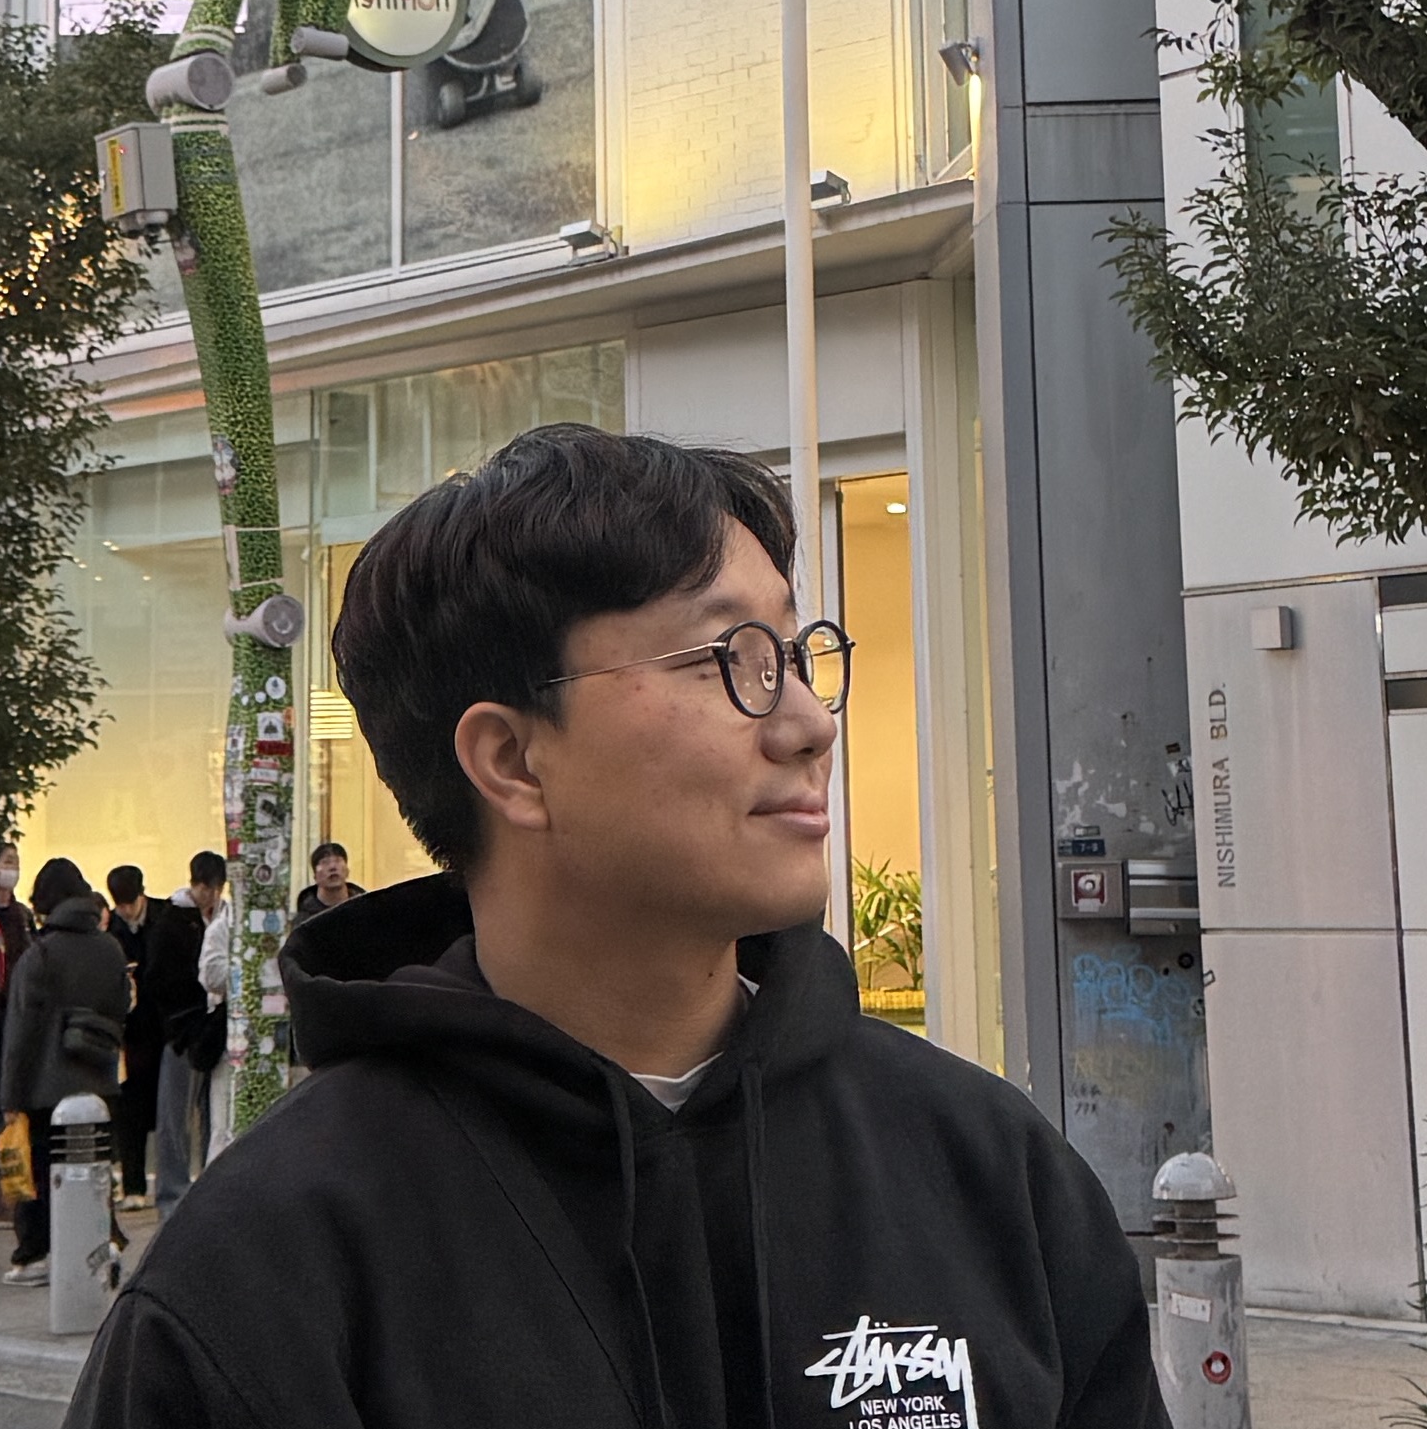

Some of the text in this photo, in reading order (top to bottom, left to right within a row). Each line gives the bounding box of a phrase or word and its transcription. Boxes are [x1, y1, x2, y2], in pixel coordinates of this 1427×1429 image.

[1208, 683, 1236, 888] NISHIMURA BLD.
[860, 1395, 946, 1416] NEW YORK
